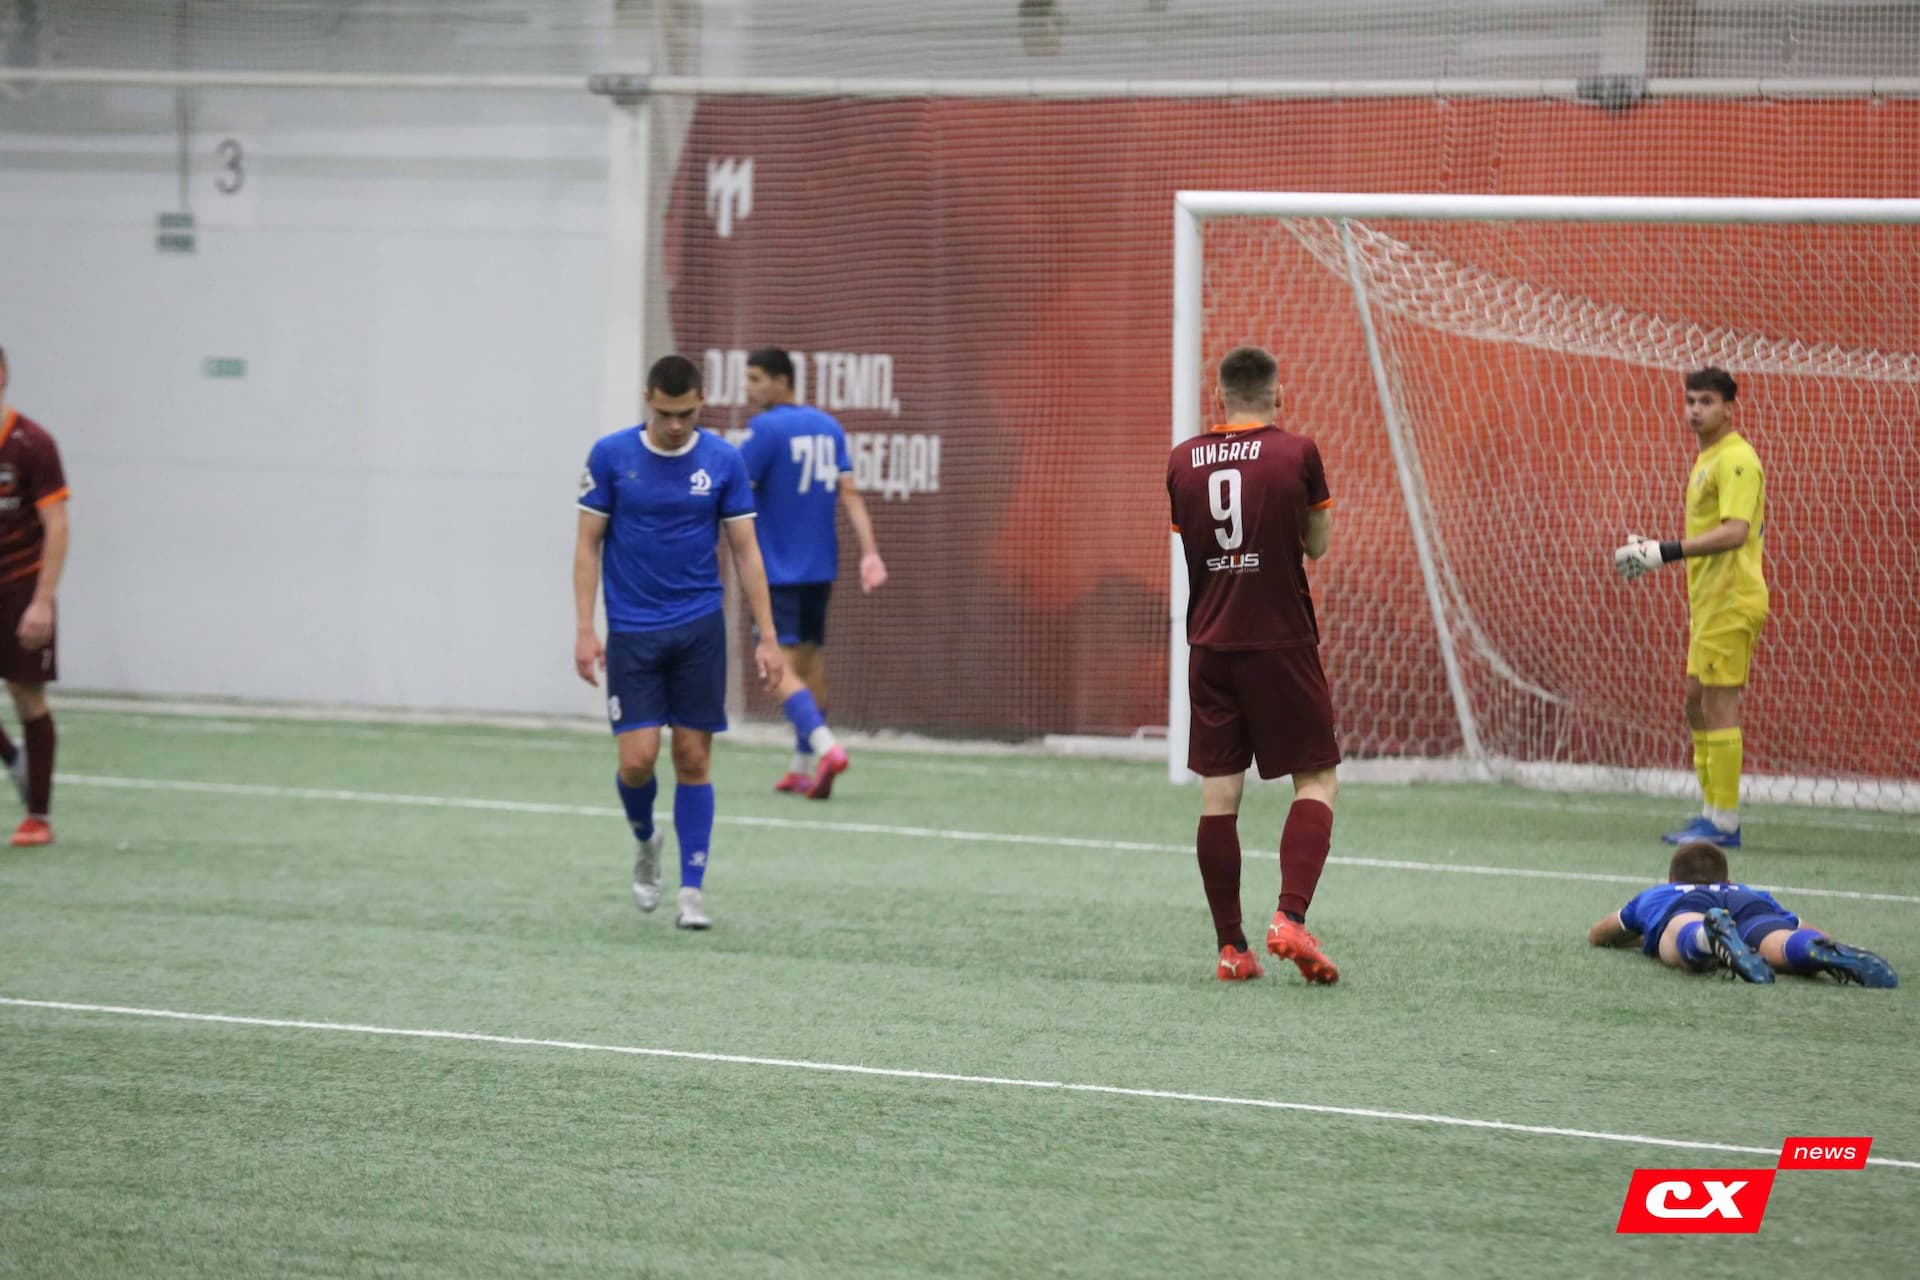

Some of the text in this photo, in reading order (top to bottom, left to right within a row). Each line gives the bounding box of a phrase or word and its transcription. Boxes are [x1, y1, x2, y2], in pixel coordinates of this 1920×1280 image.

[215, 138, 246, 196] 3
[813, 352, 900, 417] ТЕМП,
[789, 433, 839, 494] 74
[1191, 440, 1262, 469] ШИБАЕВ
[1208, 468, 1243, 550] 9
